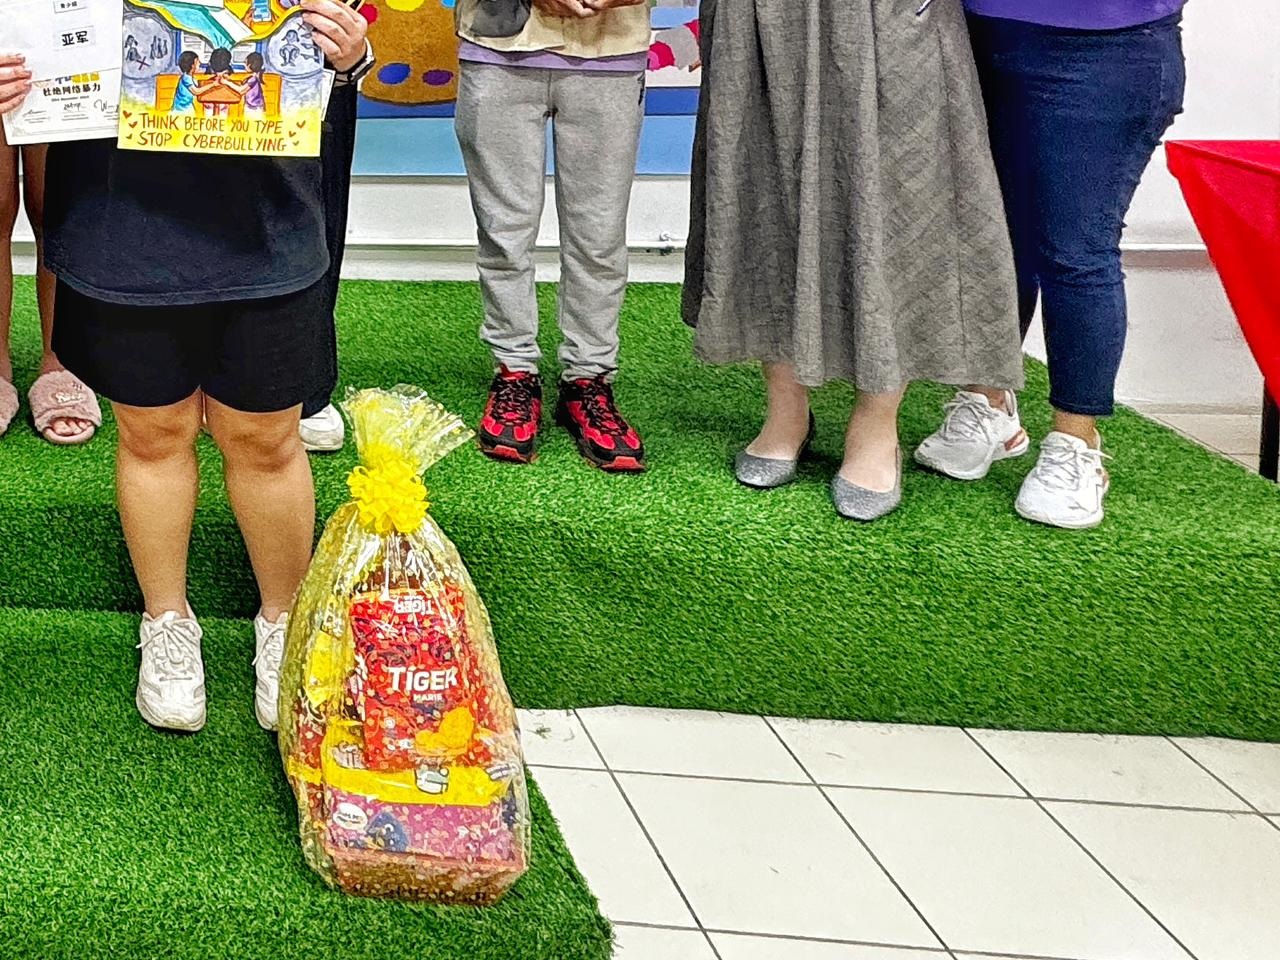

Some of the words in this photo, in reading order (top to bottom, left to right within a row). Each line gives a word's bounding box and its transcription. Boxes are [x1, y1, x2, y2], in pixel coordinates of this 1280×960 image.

[61, 30, 89, 47] 亚军
[42, 82, 101, 97] 杜绝网络暴力
[139, 112, 180, 131] THINK
[184, 116, 225, 132] BEFORE
[230, 119, 250, 133] YOU
[255, 119, 284, 135] TYPE
[137, 130, 173, 147] STOP
[182, 133, 287, 152] CYBERBULLYING
[388, 666, 458, 692] TIGER
